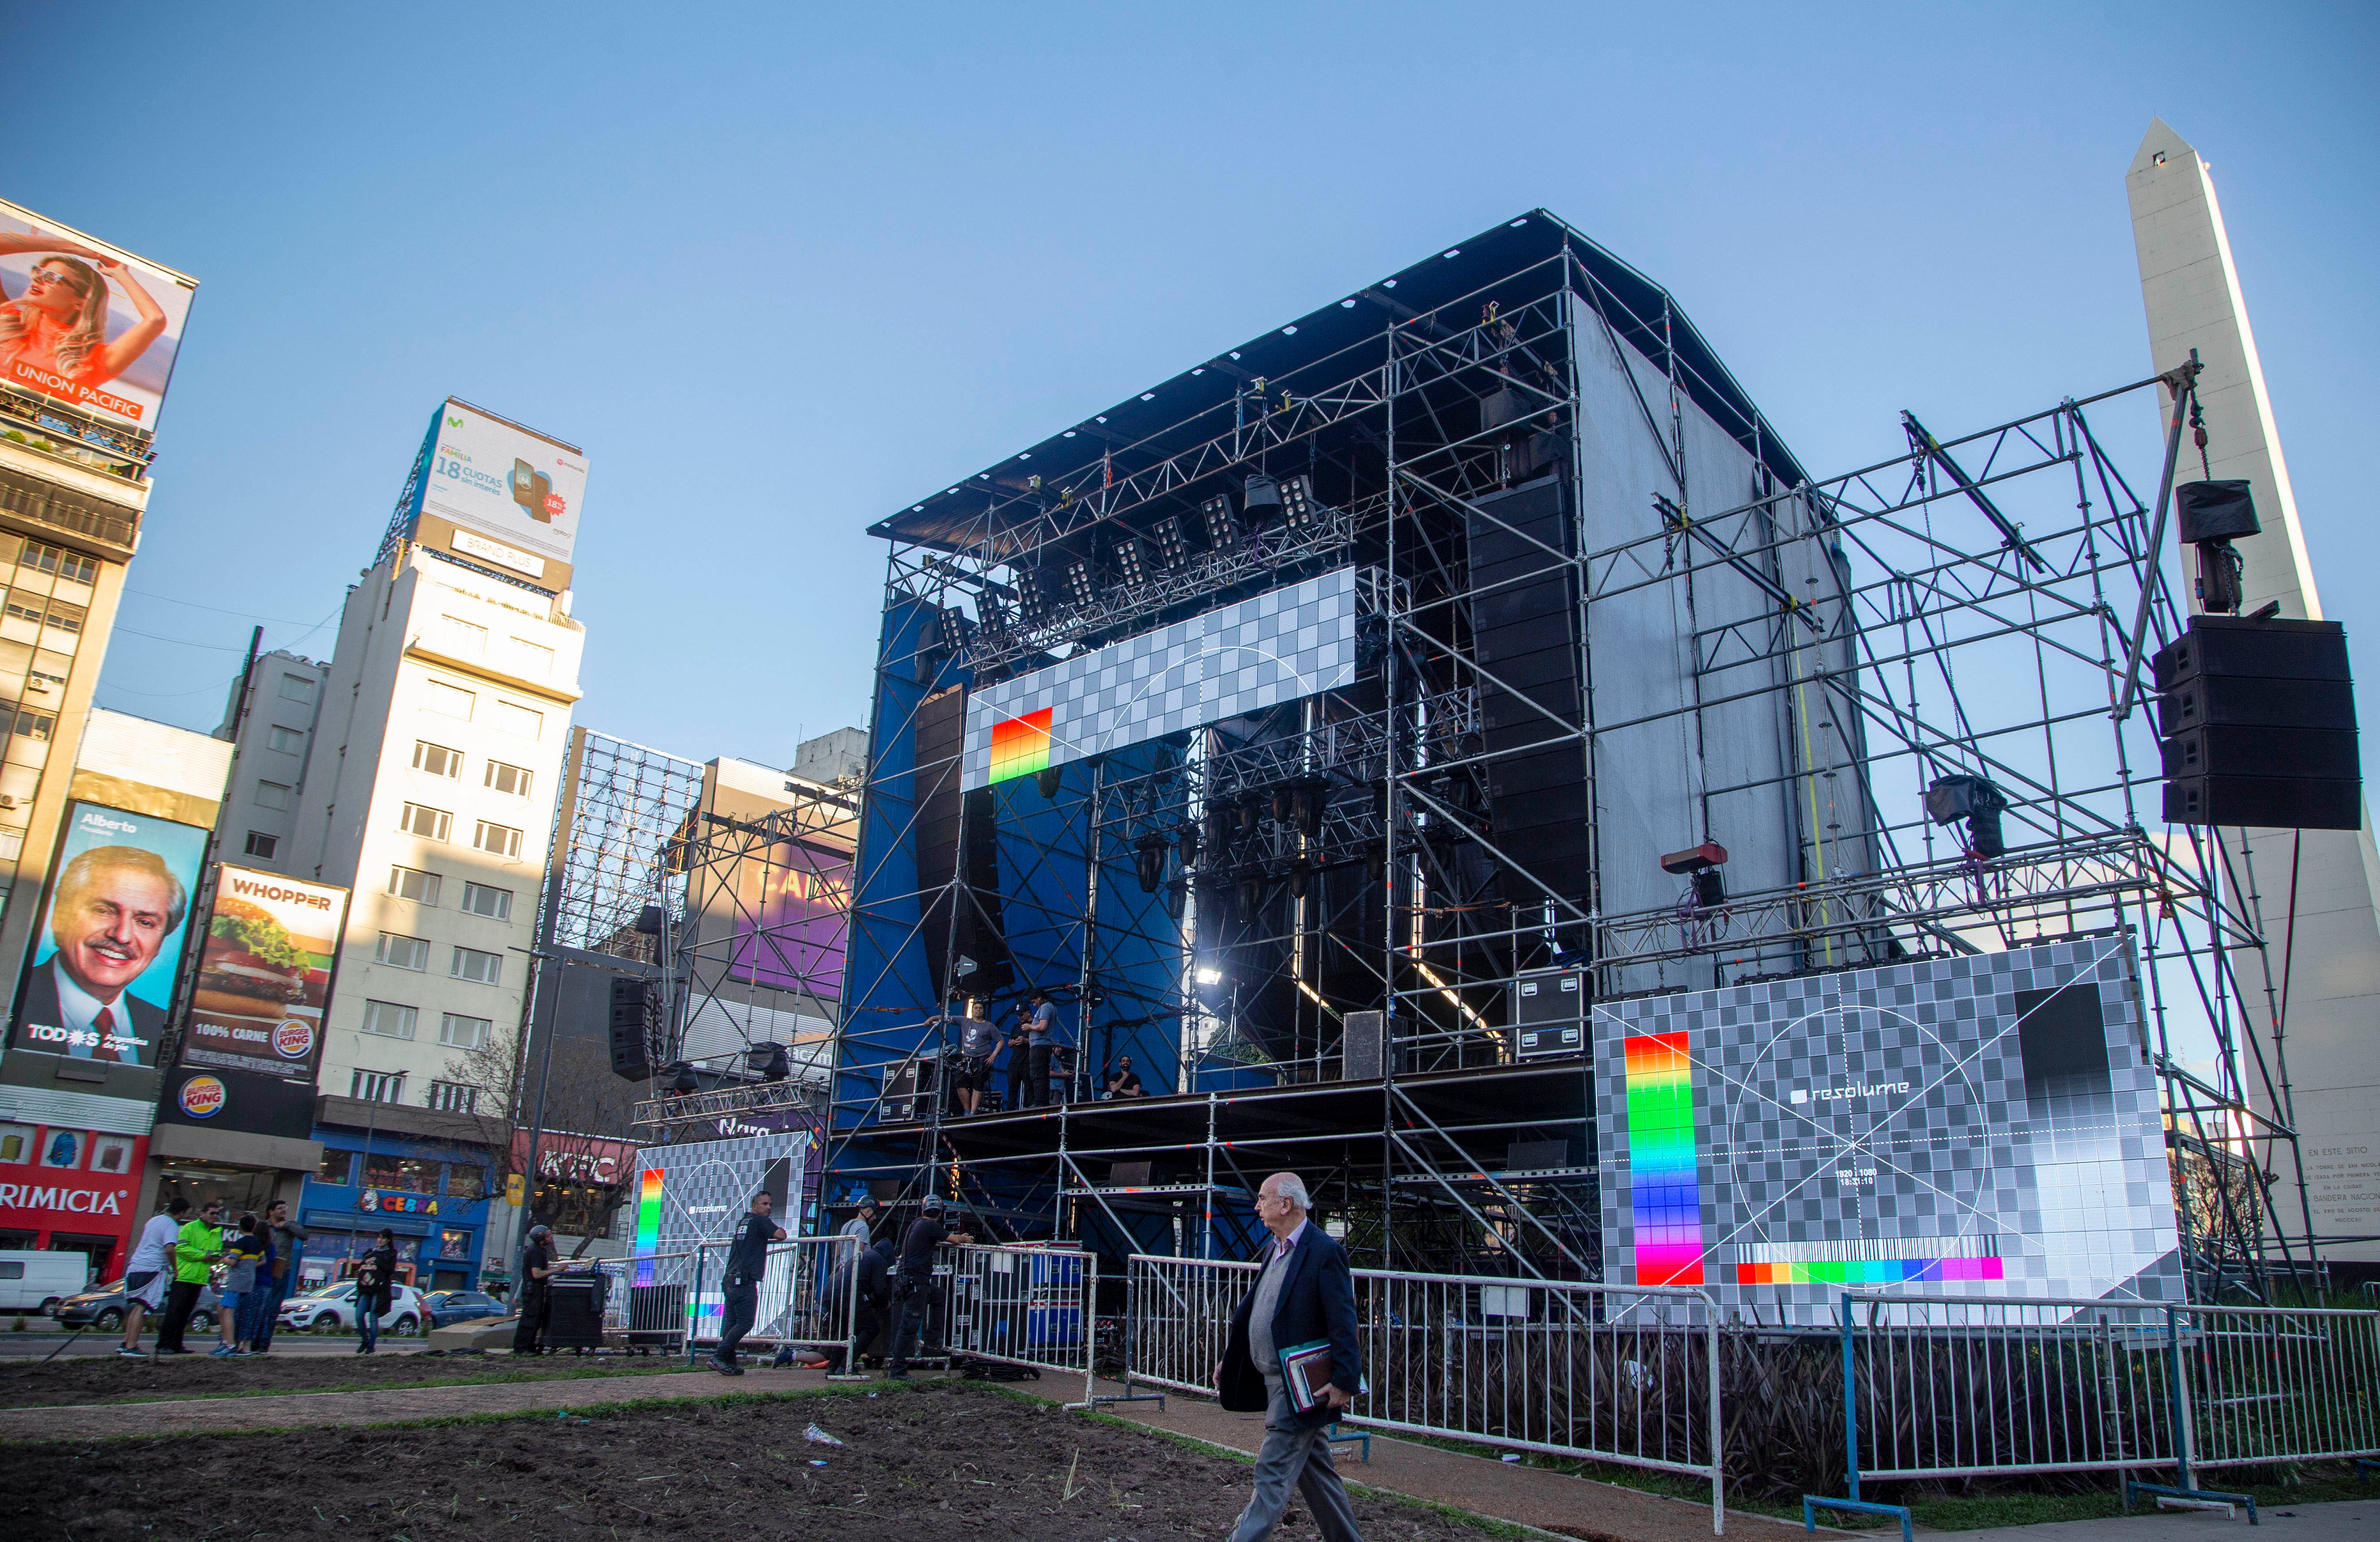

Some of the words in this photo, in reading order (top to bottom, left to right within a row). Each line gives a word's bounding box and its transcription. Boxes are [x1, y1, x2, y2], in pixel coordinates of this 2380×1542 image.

[17, 363, 75, 394] UNION
[79, 387, 139, 417] PACIFIC
[441, 446, 472, 463] FAMILIA
[436, 456, 461, 479] 18
[463, 467, 503, 488] CUOTAS
[461, 477, 472, 485] sin
[473, 480, 501, 496] interés
[467, 537, 505, 558] BRAND
[507, 552, 532, 567] PLUS
[80, 813, 137, 833] Alberto
[233, 878, 332, 911] WHOPPER
[104, 1034, 149, 1046] Argentina
[196, 1023, 230, 1038] 100%
[232, 1028, 269, 1043] CARNE
[279, 1028, 309, 1037] BURGER
[102, 1041, 115, 1049] de
[113, 1043, 130, 1052] pie
[278, 1035, 309, 1047] KING
[186, 1084, 221, 1096] BURGER
[1812, 1081, 1910, 1101] resolume
[184, 1092, 222, 1107] KING
[2322, 1148, 2342, 1156] ESTE
[2346, 1146, 2367, 1154] SITIO
[1835, 1169, 1853, 1178] 1920
[1859, 1168, 1877, 1177] 1080
[383, 1196, 438, 1216] CEBRA
[2313, 1194, 2347, 1202] BANDERA
[696, 1203, 728, 1213] resolume
